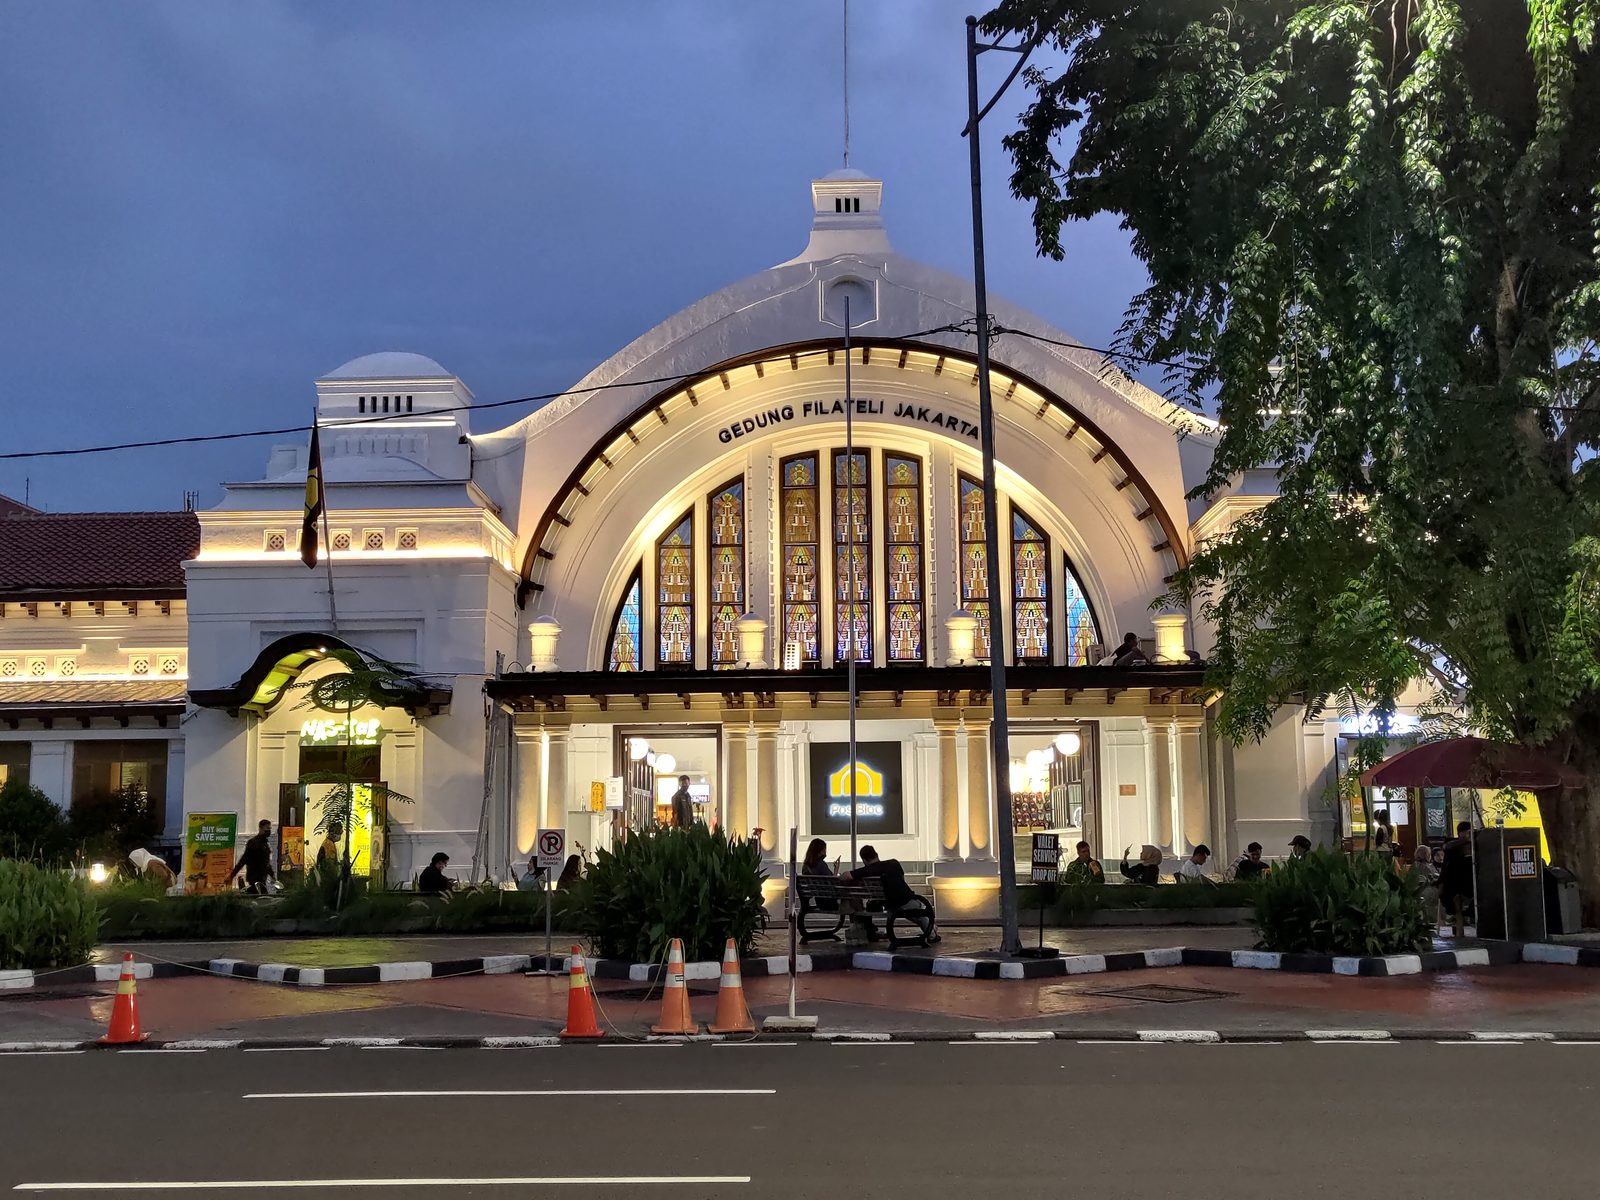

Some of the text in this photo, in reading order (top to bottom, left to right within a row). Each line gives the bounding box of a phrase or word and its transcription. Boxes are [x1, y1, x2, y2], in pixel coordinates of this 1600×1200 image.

[718, 399, 979, 444] GEDUNG FILATELI JAKARTA
[830, 803, 883, 816] Pos Bloc
[195, 833, 215, 841] SAVE
[1037, 835, 1054, 849] VALET
[1033, 849, 1058, 863] SERVICE
[1513, 849, 1530, 862] VALET
[1033, 868, 1057, 882] DROP OFF
[1511, 861, 1535, 876] SERVICE
